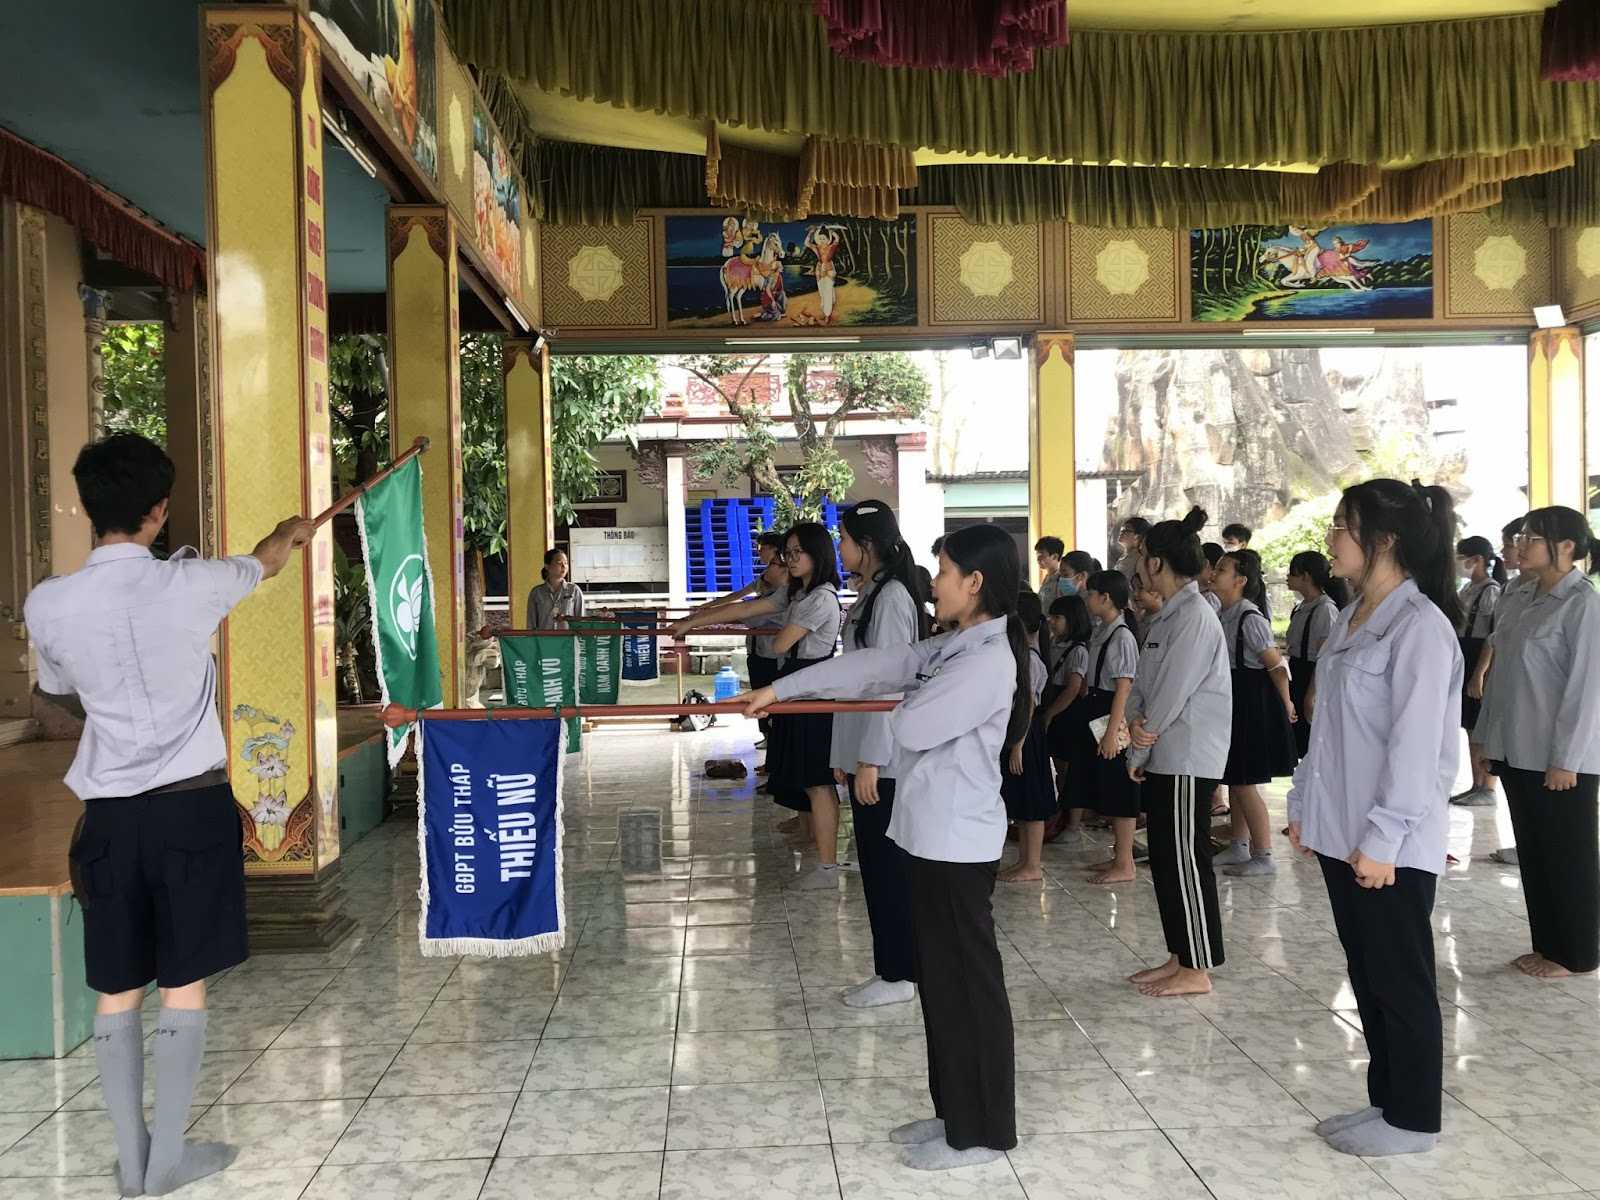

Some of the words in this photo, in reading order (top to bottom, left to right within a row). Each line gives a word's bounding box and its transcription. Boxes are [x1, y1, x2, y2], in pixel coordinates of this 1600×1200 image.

[603, 530, 622, 540] THÔNG
[623, 529, 635, 540] BÁO
[513, 659, 527, 684] THÁP
[538, 657, 562, 676] VŨ
[596, 648, 610, 673] OANH
[596, 674, 611, 693] NAM
[448, 762, 472, 807] THÁP
[486, 772, 537, 807] NỮ
[448, 812, 475, 847] BỬU
[484, 811, 537, 883] THIẾU
[454, 852, 476, 894] GĐPT
